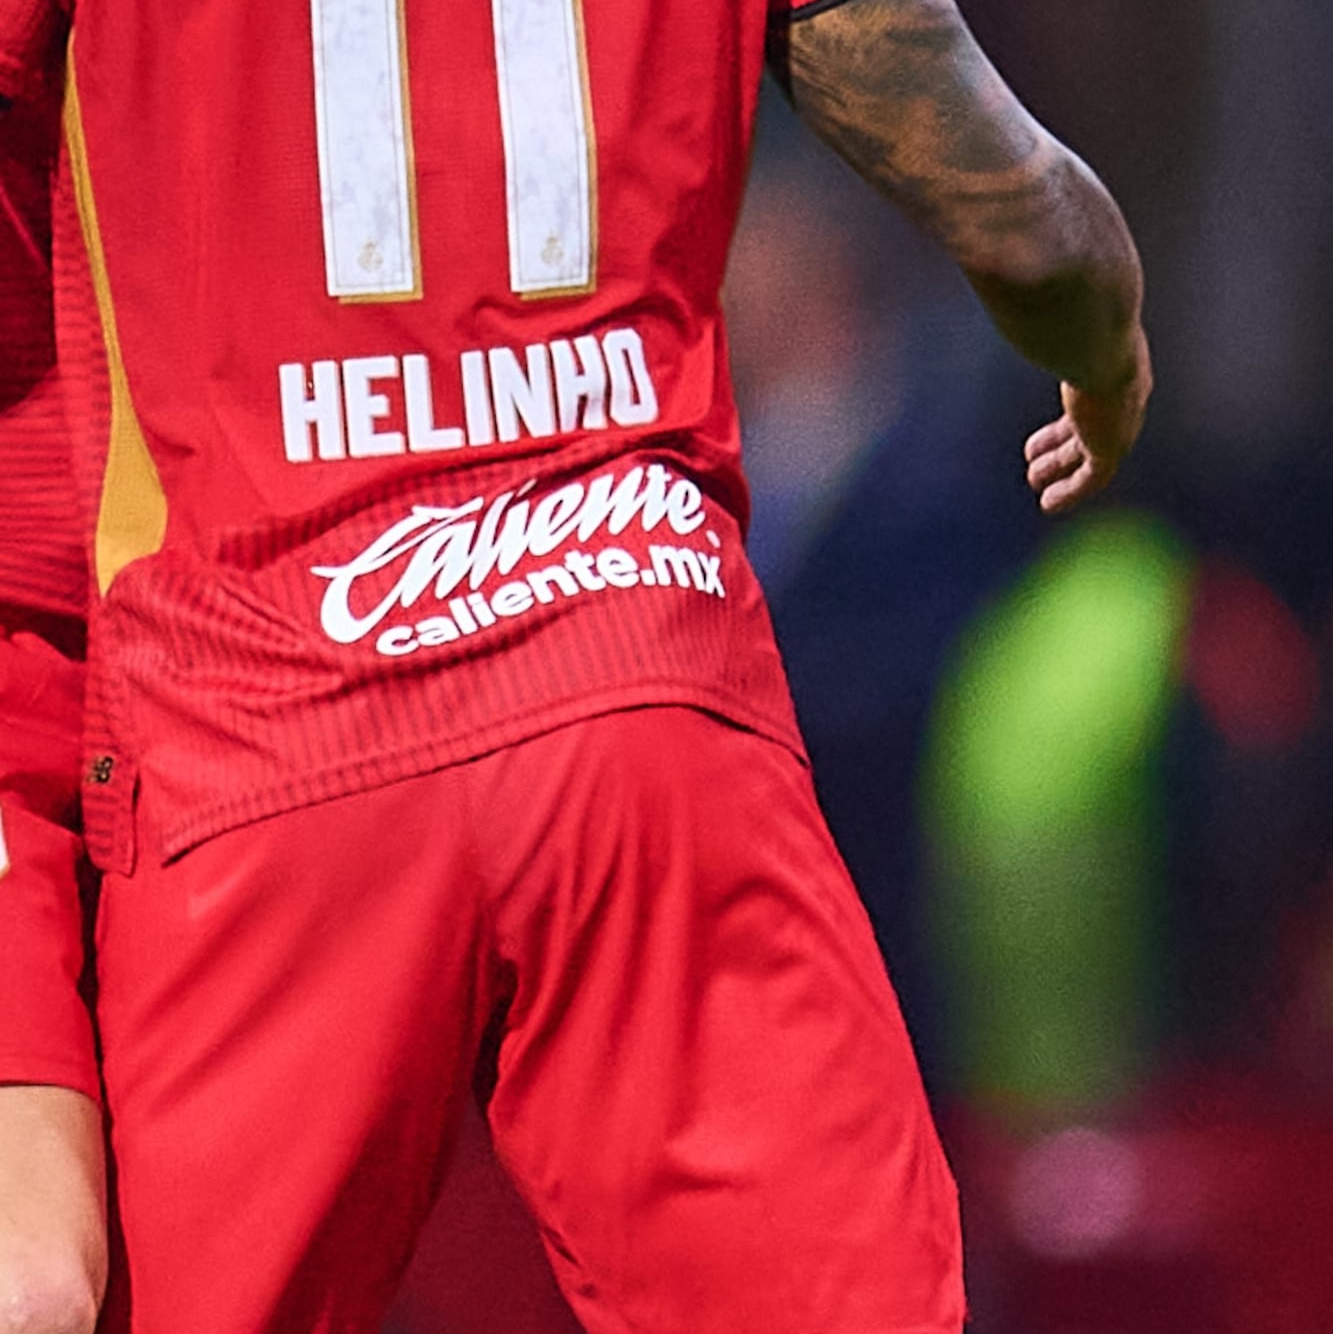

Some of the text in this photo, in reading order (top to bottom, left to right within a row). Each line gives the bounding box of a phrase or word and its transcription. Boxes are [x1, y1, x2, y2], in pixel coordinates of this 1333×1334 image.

[279, 328, 660, 463] HELINHO
[310, 464, 706, 643] Caliente
[375, 544, 727, 656] caliente.mx
